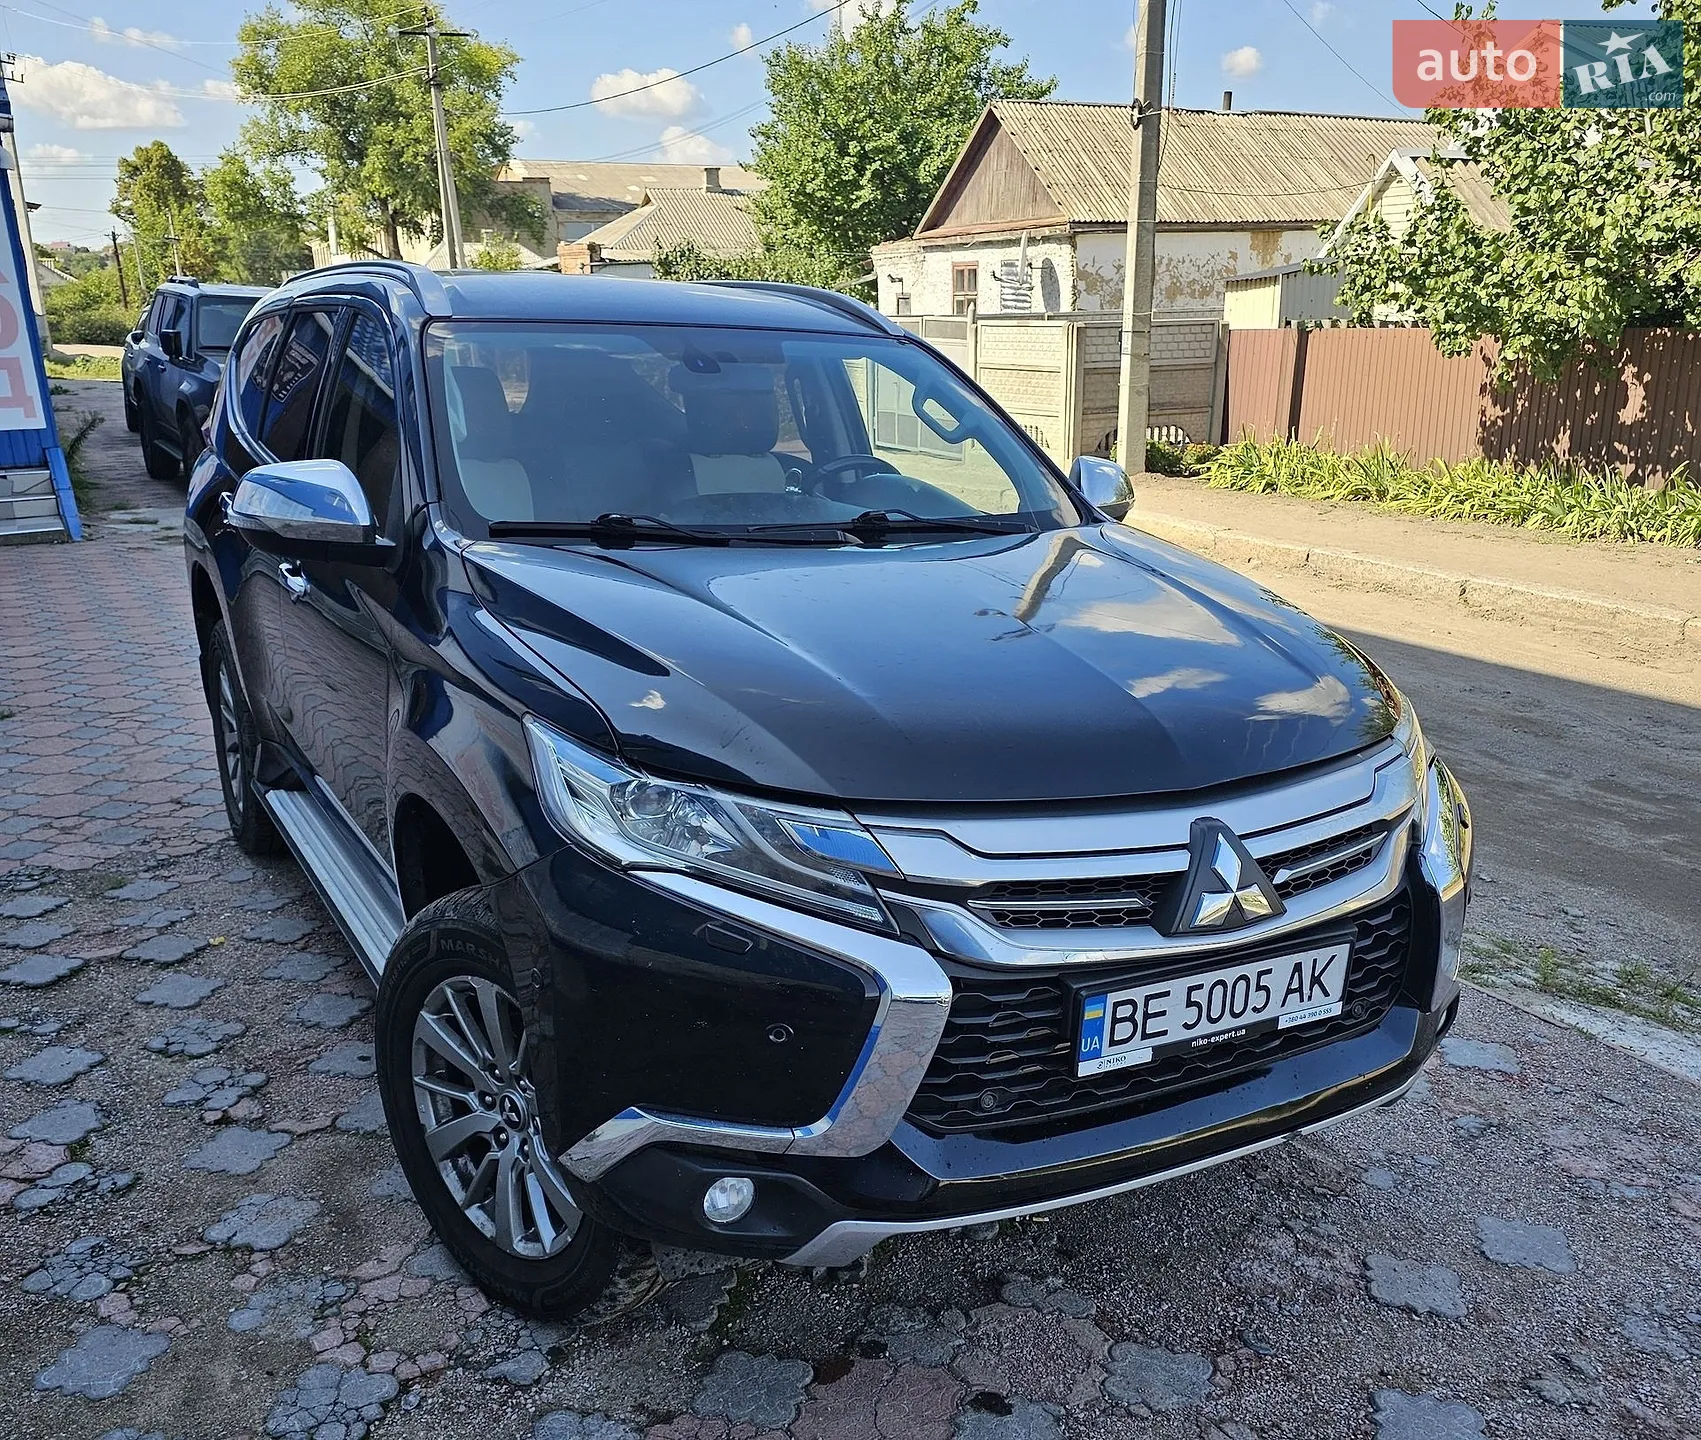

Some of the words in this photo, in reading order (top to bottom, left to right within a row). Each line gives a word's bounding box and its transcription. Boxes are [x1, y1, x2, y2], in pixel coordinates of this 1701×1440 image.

[1108, 990, 1171, 1049] BE
[1181, 967, 1274, 1032] 5005
[1280, 953, 1338, 1008] AK
[1081, 1035, 1100, 1052] UA
[1191, 1028, 1246, 1048] niko-expert.ua
[1106, 1055, 1127, 1065] NIKO
